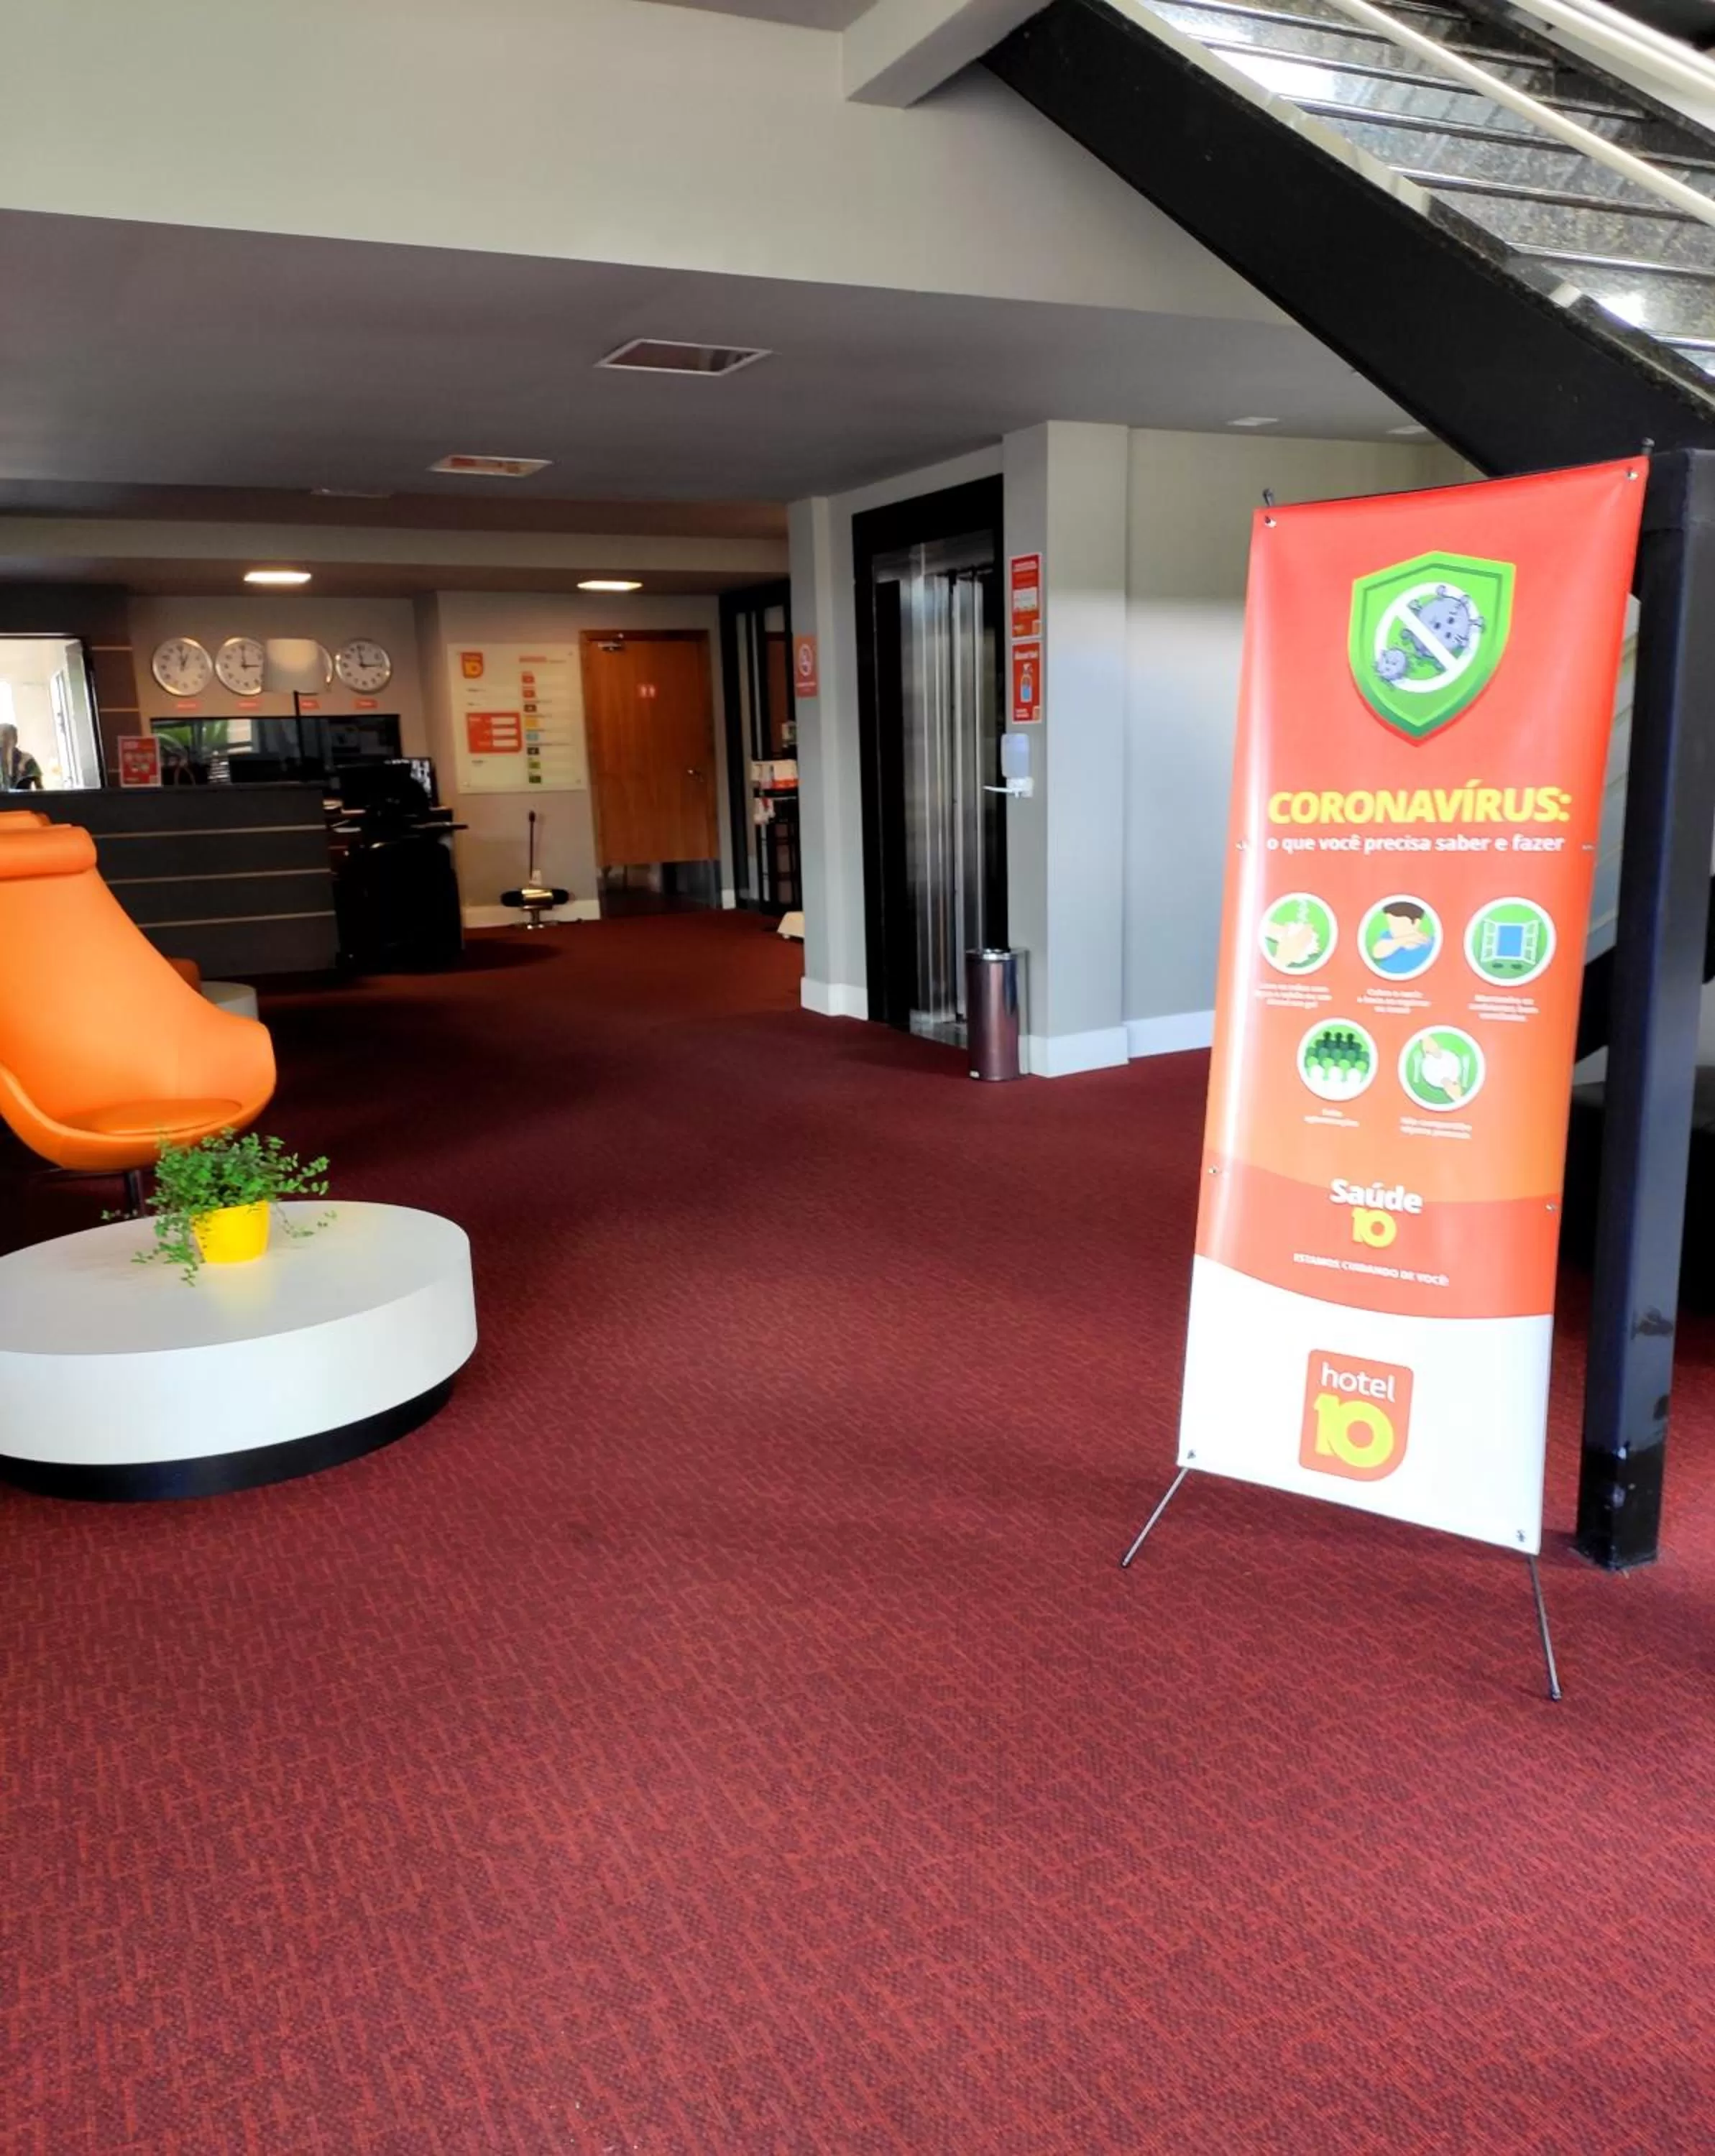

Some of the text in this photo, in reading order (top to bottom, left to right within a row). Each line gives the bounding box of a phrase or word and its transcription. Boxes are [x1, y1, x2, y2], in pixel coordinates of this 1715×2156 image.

[1267, 779, 1573, 824] CORONAVÍRUS:
[1267, 833, 1565, 854] o que você precisa saber e fazer
[1330, 1179, 1423, 1214] Saúde
[1351, 1207, 1397, 1248] 10
[1399, 1269, 1415, 1281] DE
[1320, 1362, 1396, 1403] hotel
[1313, 1393, 1394, 1468] 10
